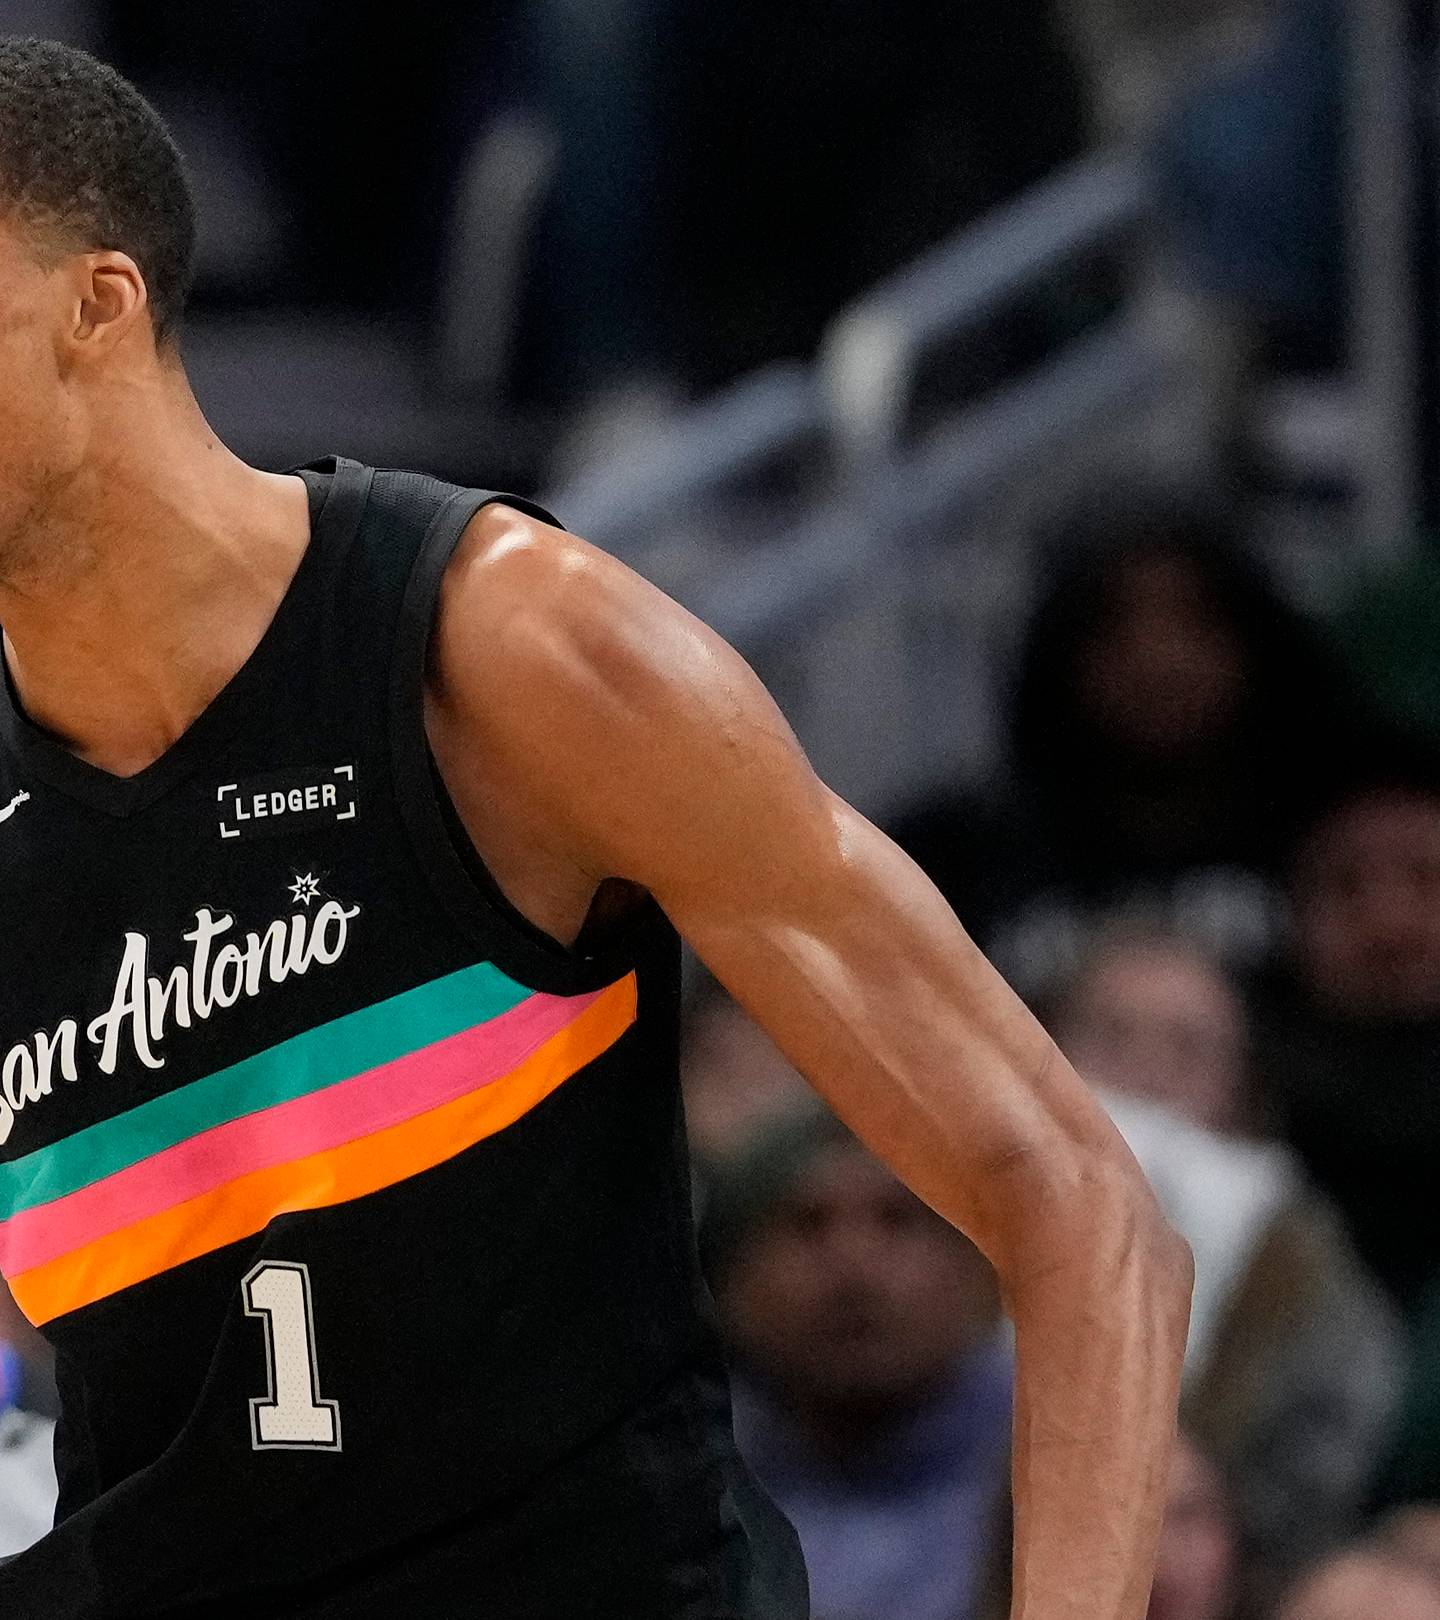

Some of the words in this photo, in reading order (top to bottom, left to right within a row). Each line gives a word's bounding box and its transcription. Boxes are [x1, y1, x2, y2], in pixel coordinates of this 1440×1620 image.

[235, 784, 337, 820] LEDGER
[87, 872, 360, 1075] Antonio
[241, 1259, 342, 1452] 1
